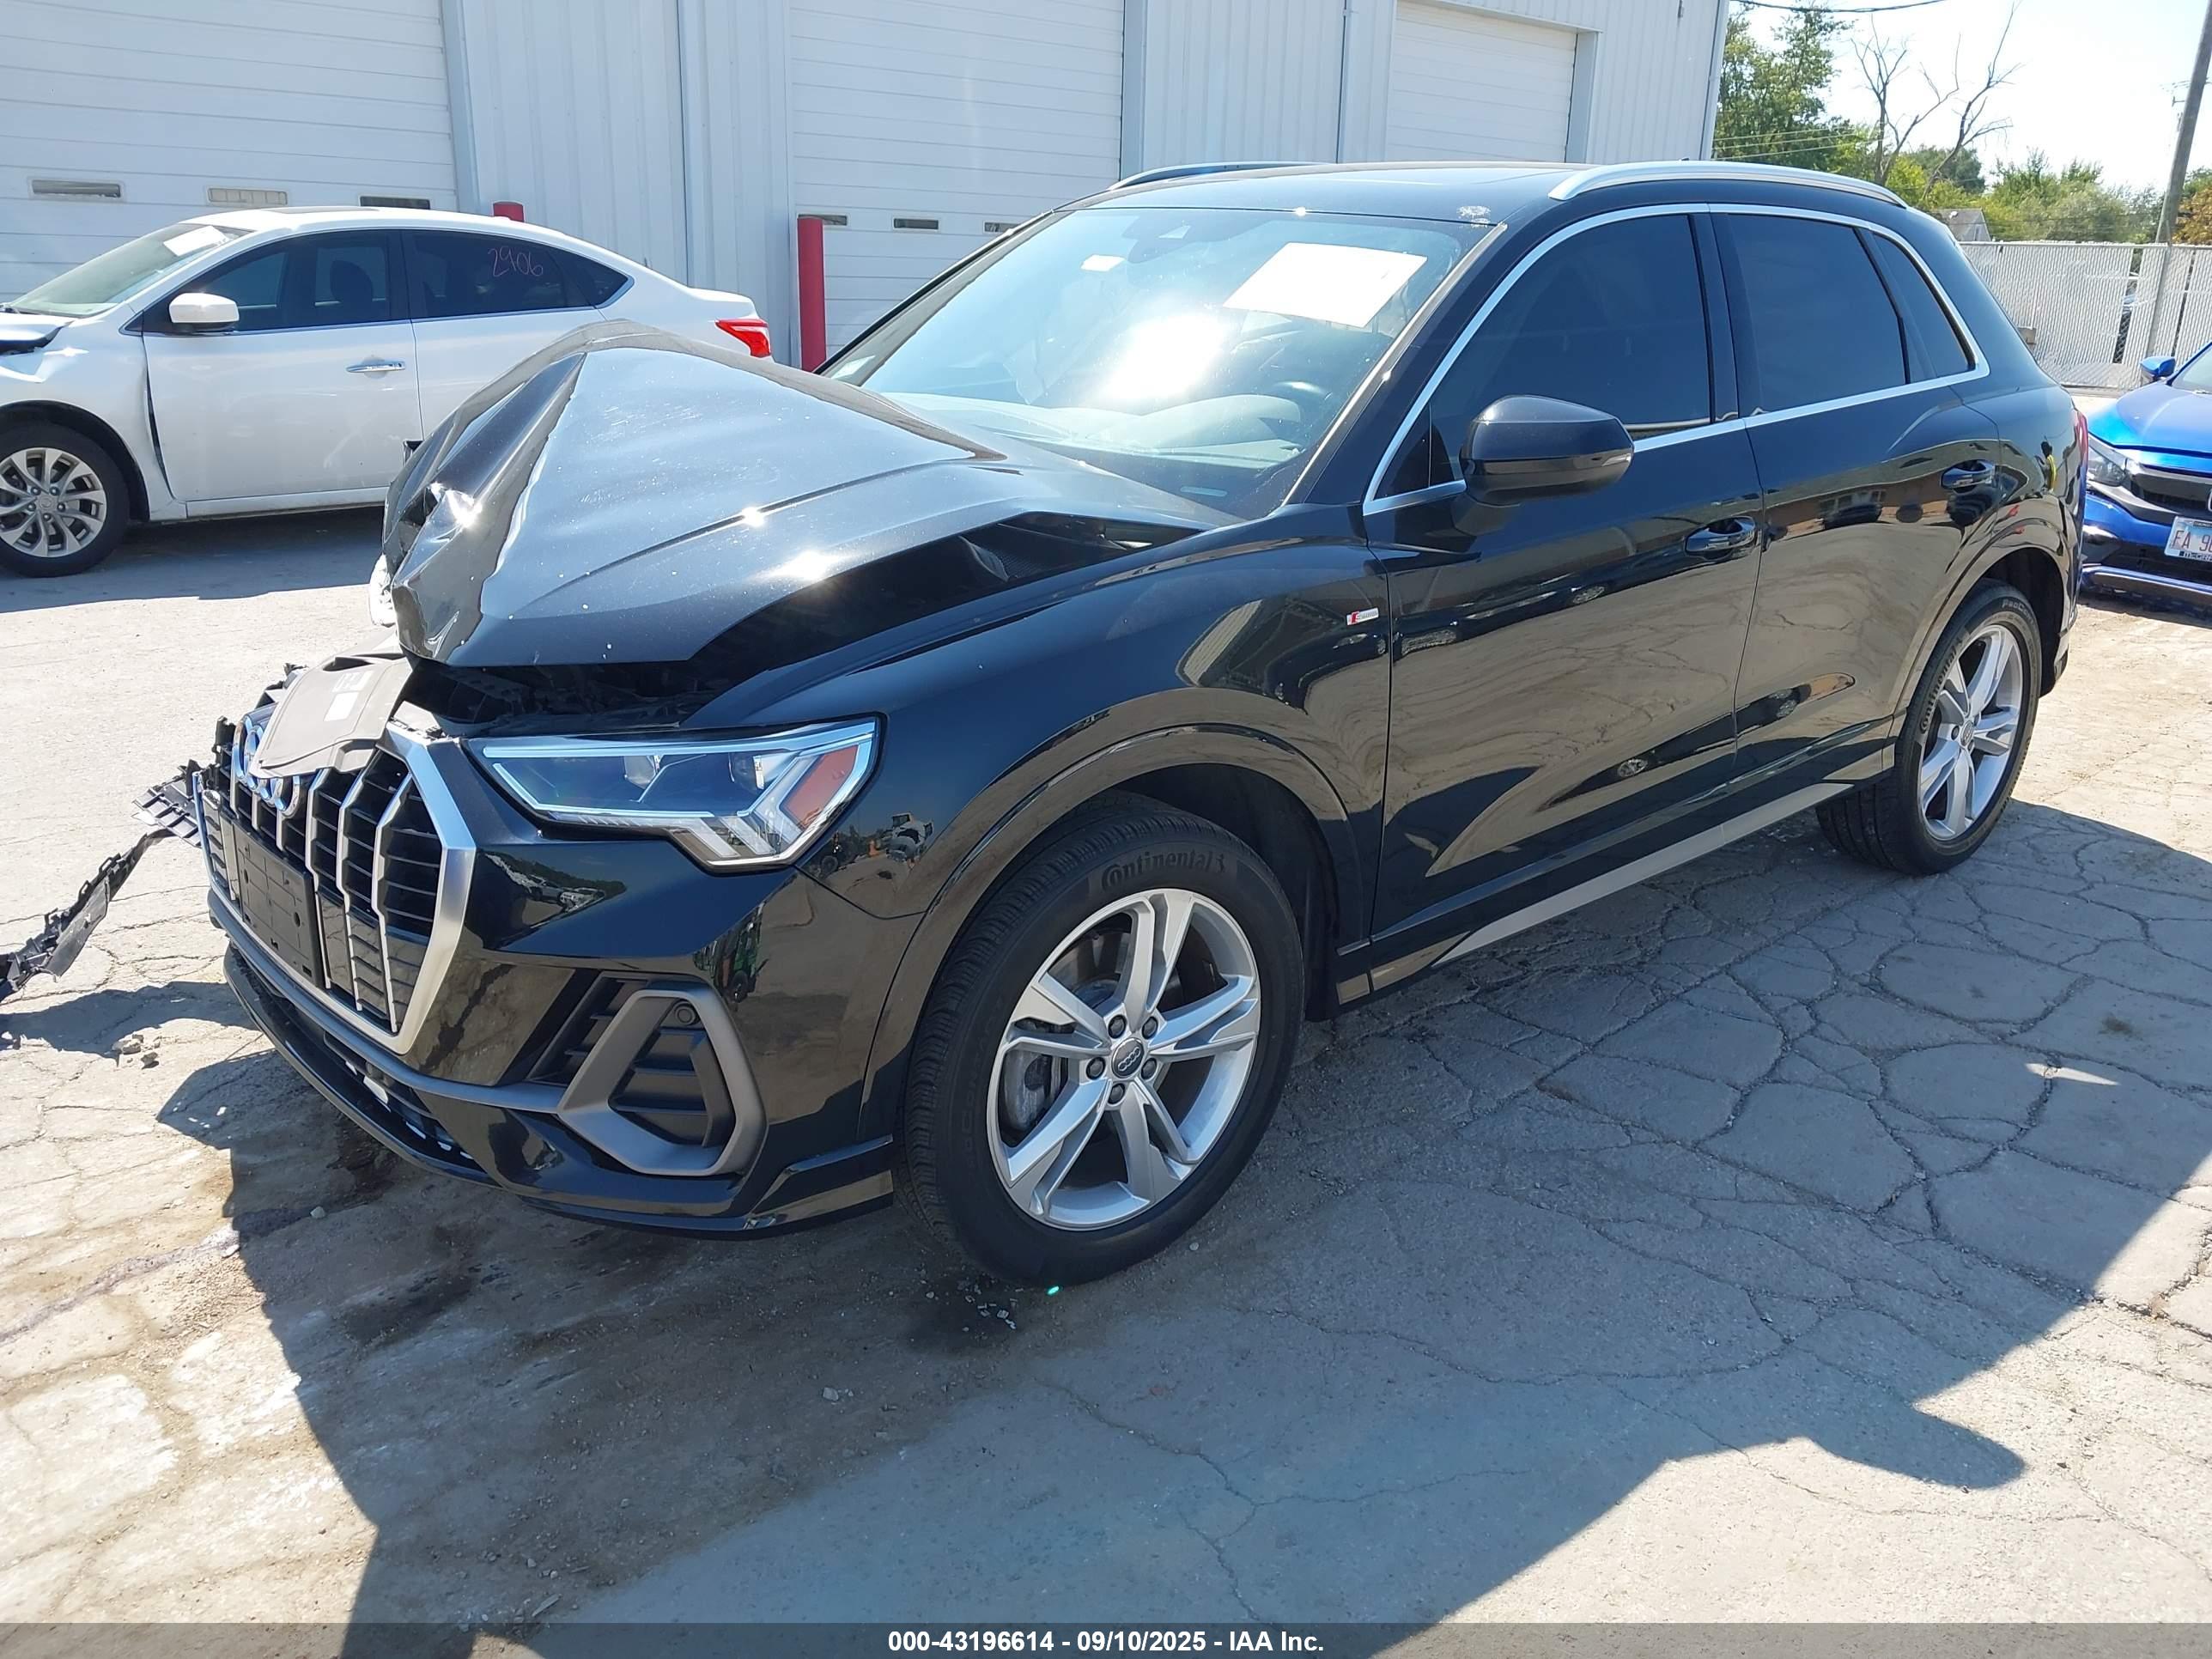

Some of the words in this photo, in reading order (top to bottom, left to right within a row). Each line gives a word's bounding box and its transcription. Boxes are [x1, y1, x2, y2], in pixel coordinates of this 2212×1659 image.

[487, 245, 544, 277] 2906
[2172, 530, 2191, 550] FA
[1102, 848, 1213, 891] Continental
